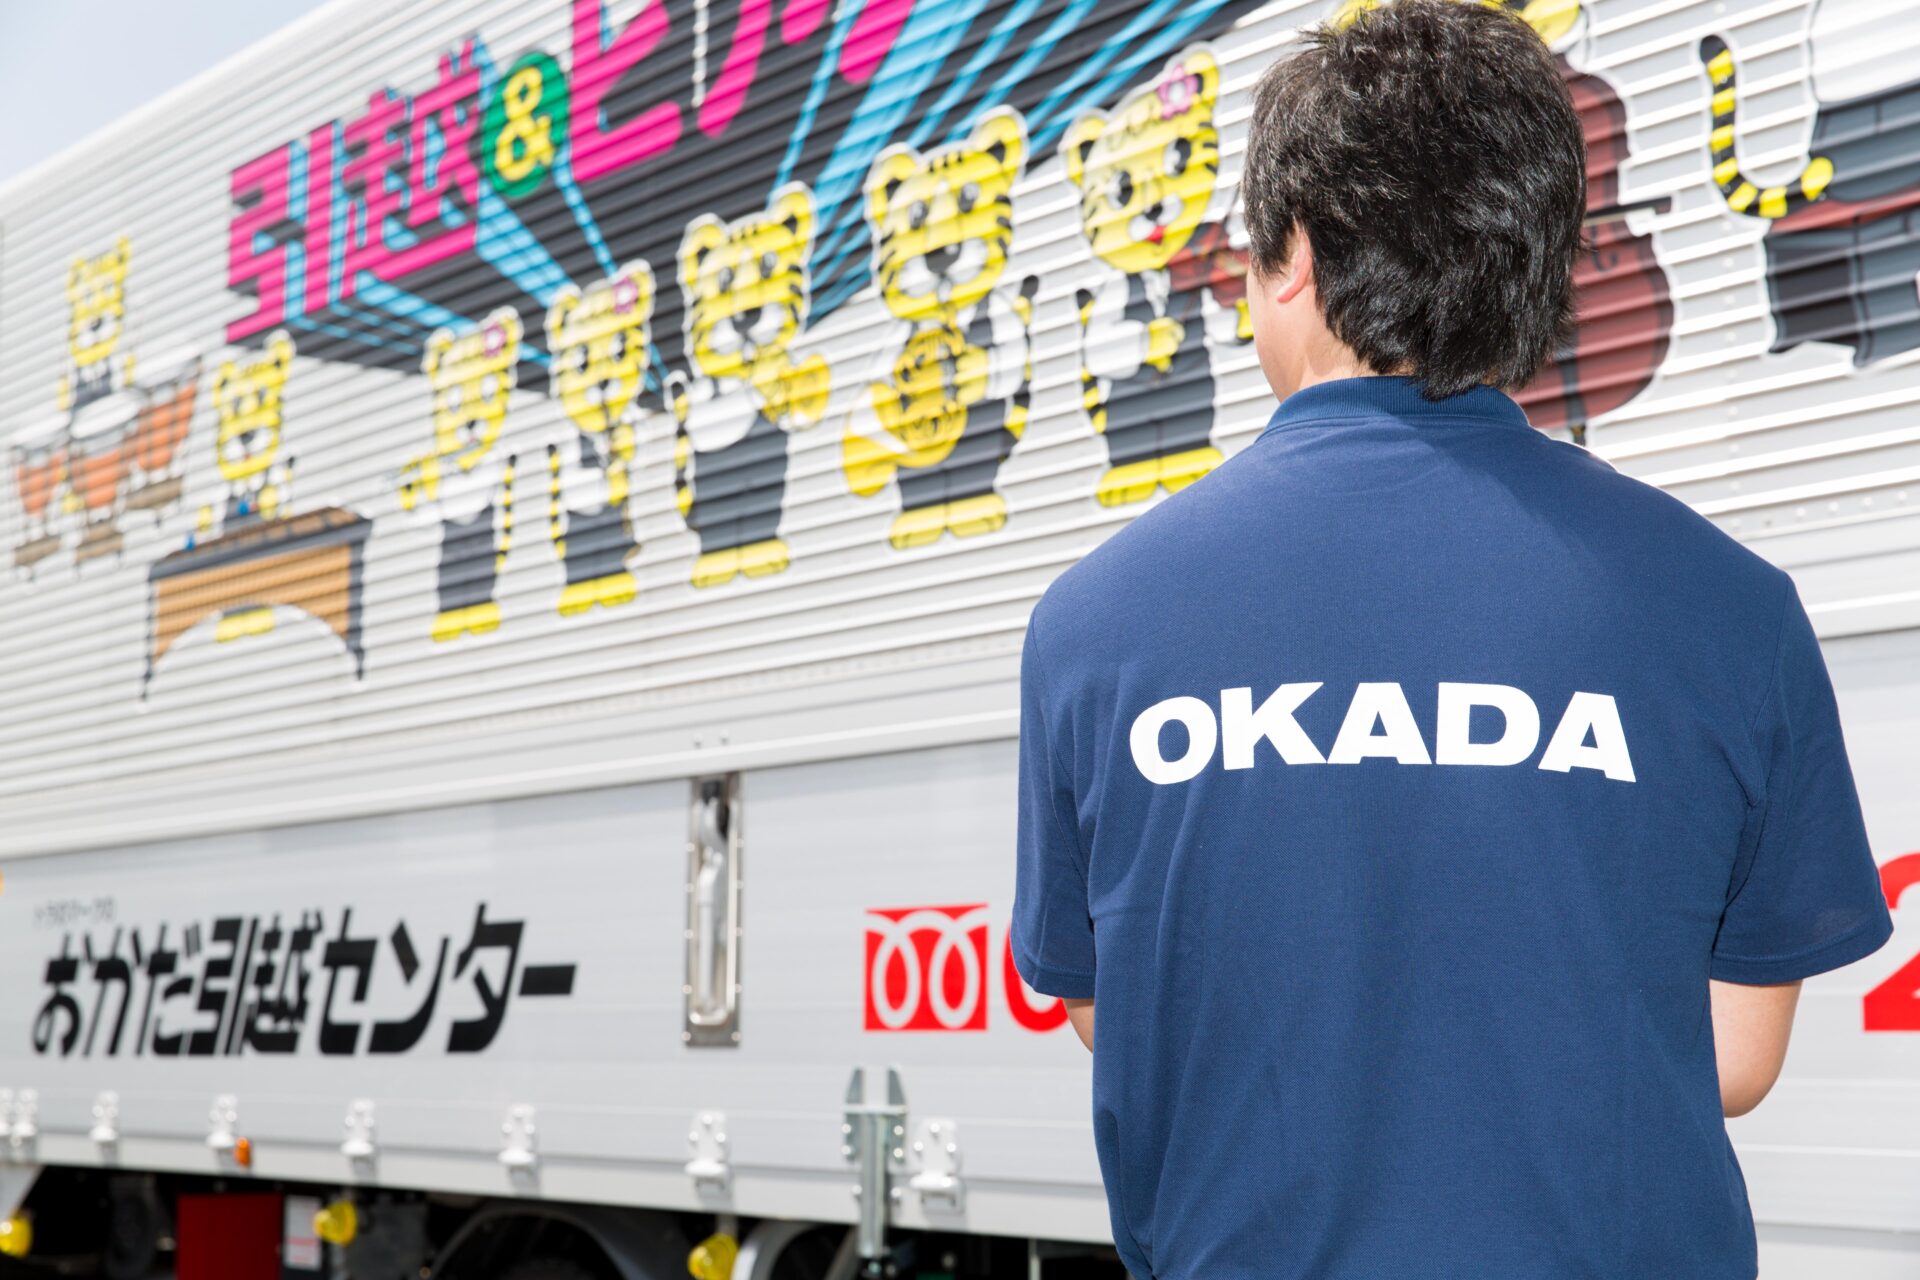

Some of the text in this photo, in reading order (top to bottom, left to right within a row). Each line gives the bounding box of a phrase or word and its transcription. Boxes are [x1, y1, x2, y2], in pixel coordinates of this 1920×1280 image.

[1130, 682, 1636, 785] OKADA
[33, 902, 577, 1057] おかだ引越センター
